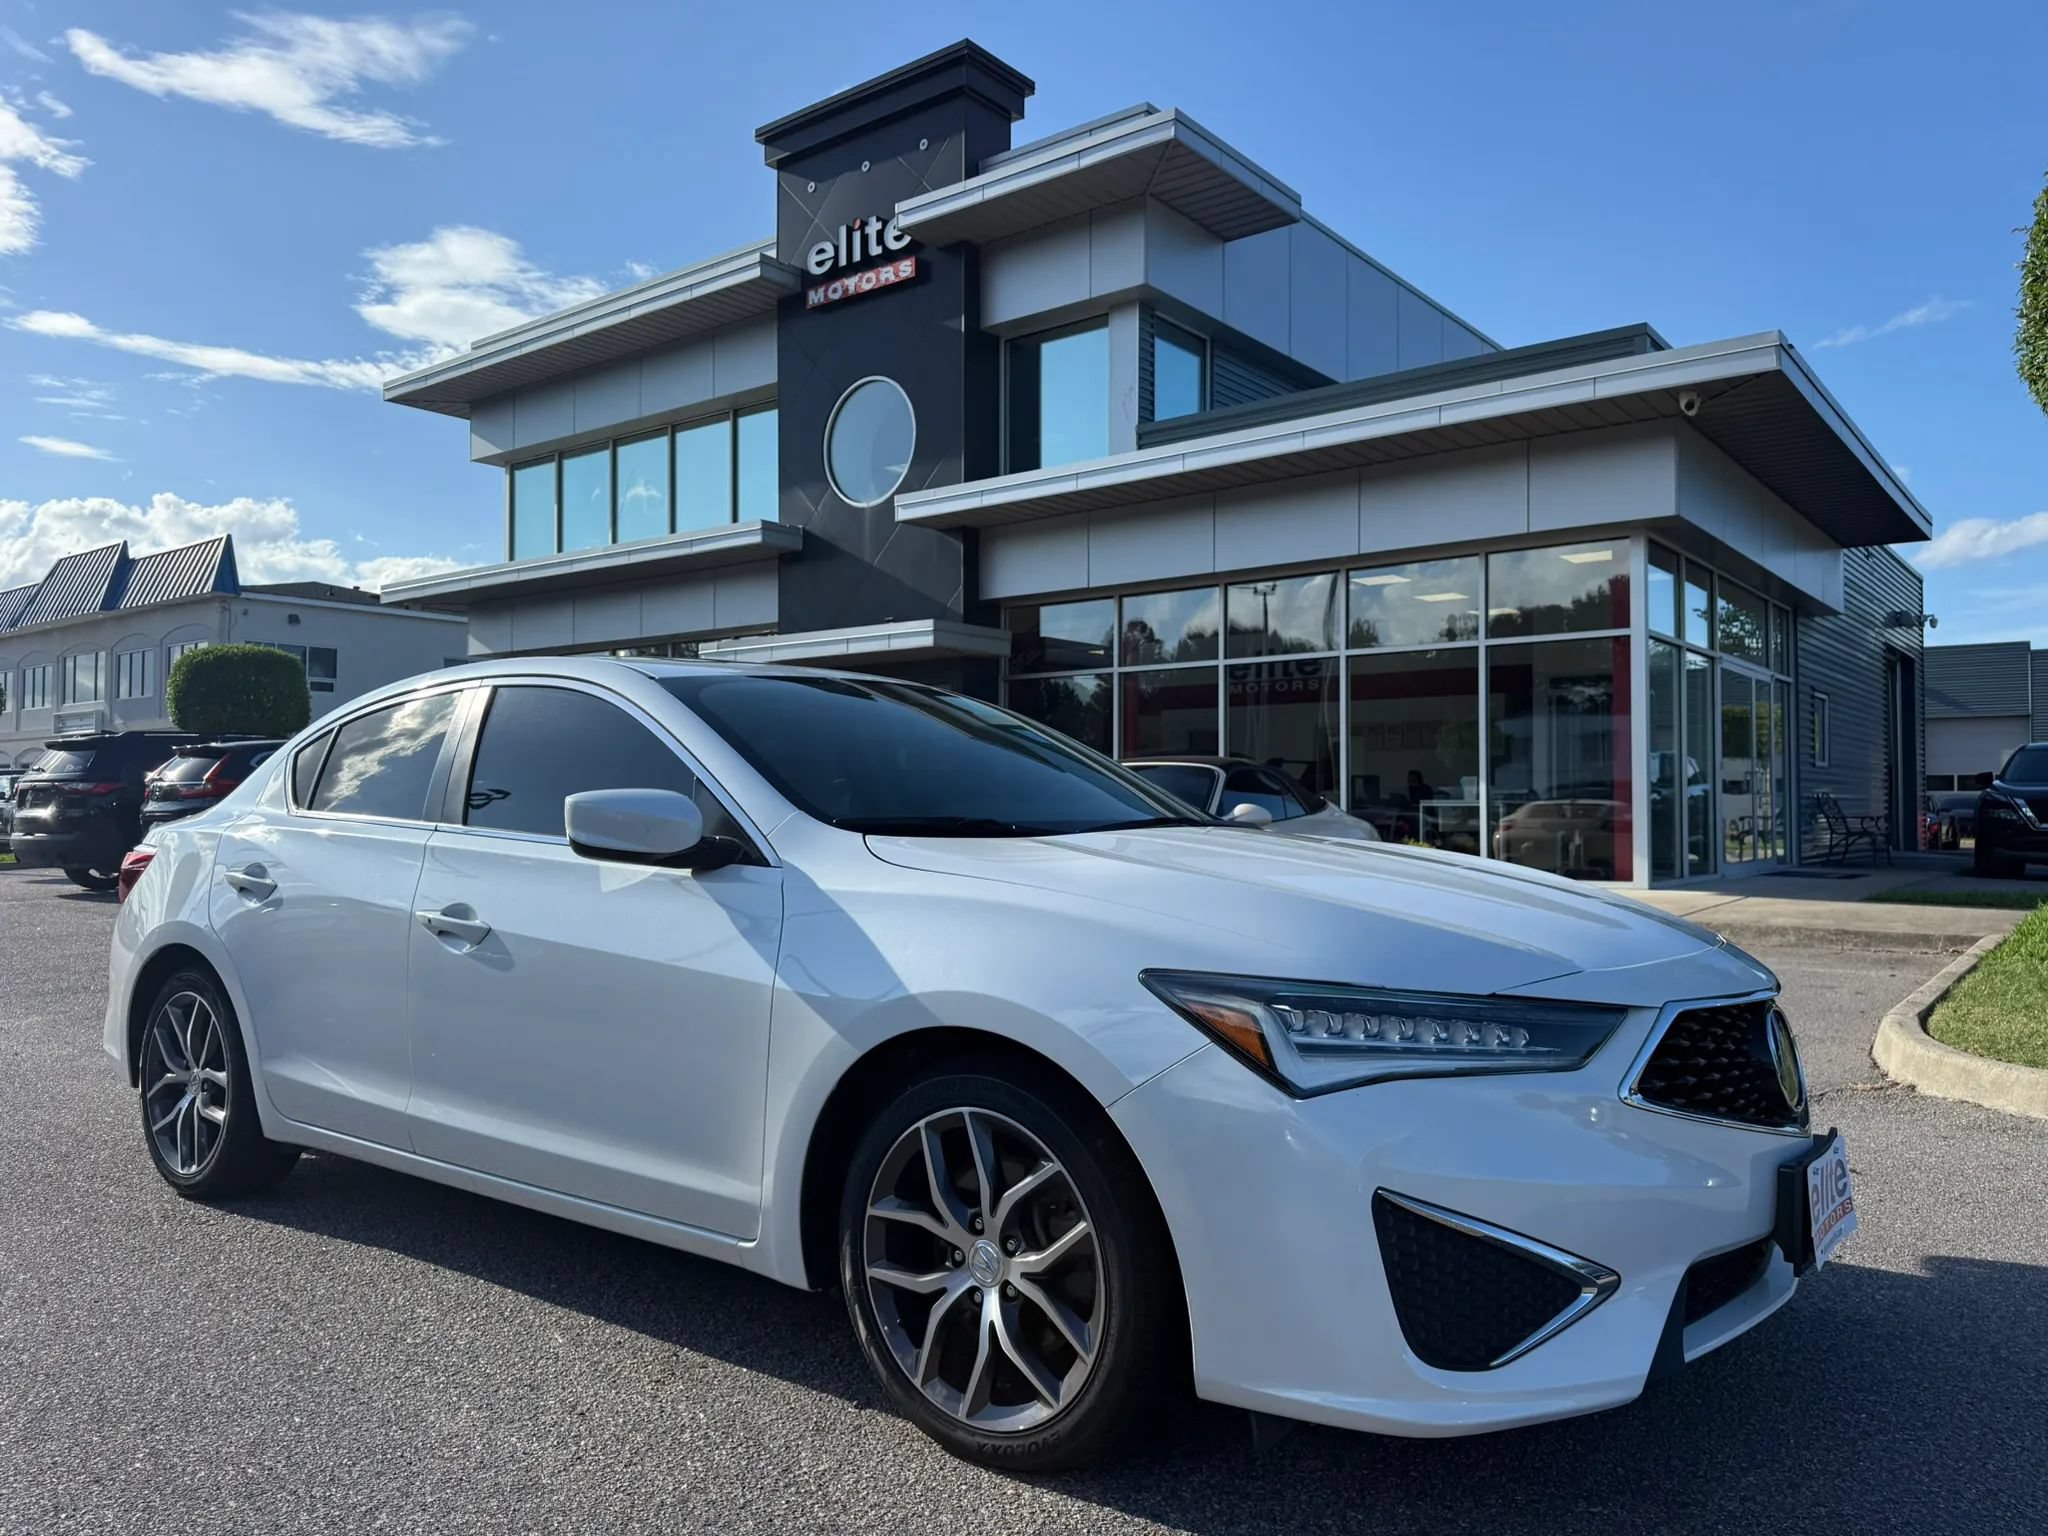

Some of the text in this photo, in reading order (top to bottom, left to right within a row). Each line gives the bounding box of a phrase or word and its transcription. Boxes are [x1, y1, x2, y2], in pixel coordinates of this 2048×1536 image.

[807, 215, 912, 275] elite
[808, 260, 912, 305] MOTORS
[1230, 679, 1320, 694] MOTORS
[1811, 1158, 1848, 1225] elite
